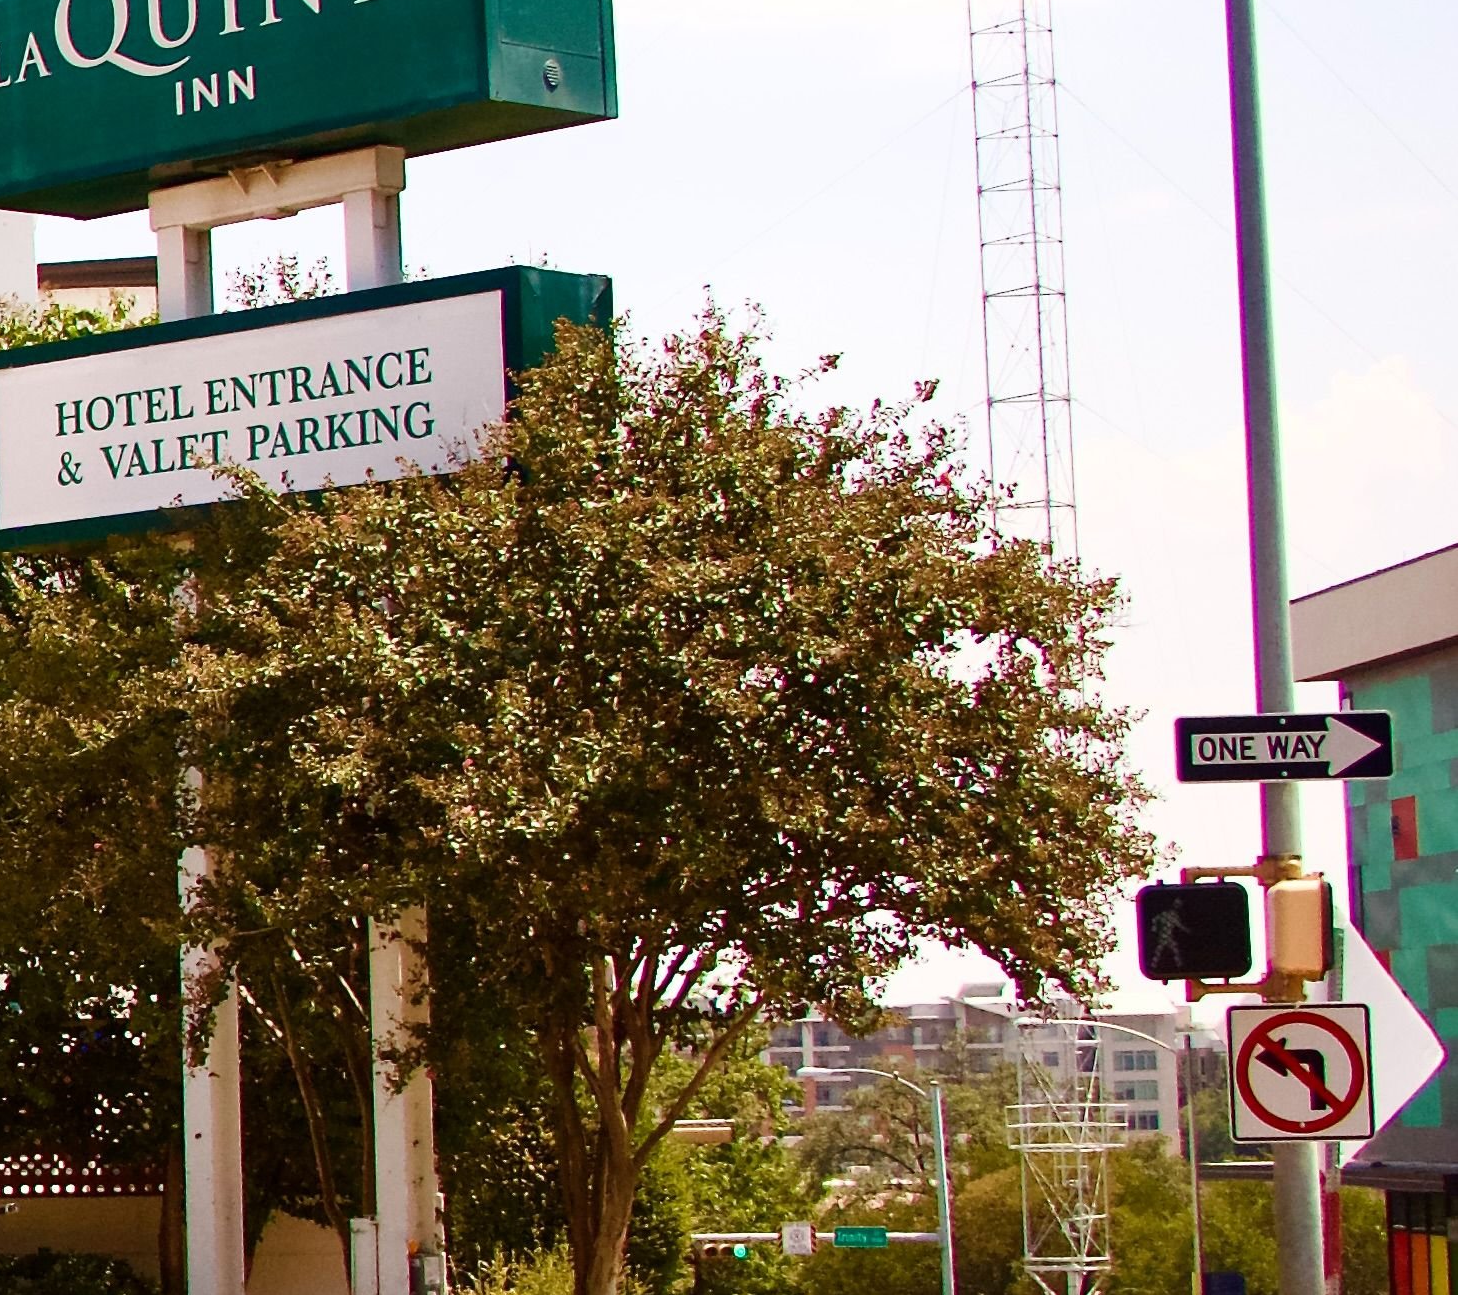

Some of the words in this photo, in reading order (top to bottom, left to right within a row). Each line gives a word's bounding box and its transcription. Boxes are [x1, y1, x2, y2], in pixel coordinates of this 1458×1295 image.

[176, 65, 256, 115] INN
[56, 385, 195, 437] HOTEL
[204, 348, 433, 415] ENTRANCE
[58, 452, 84, 487] &
[100, 430, 229, 480] VALET
[247, 402, 435, 462] PARKING
[1198, 736, 1256, 761] ONE
[1266, 734, 1326, 759] WAY
